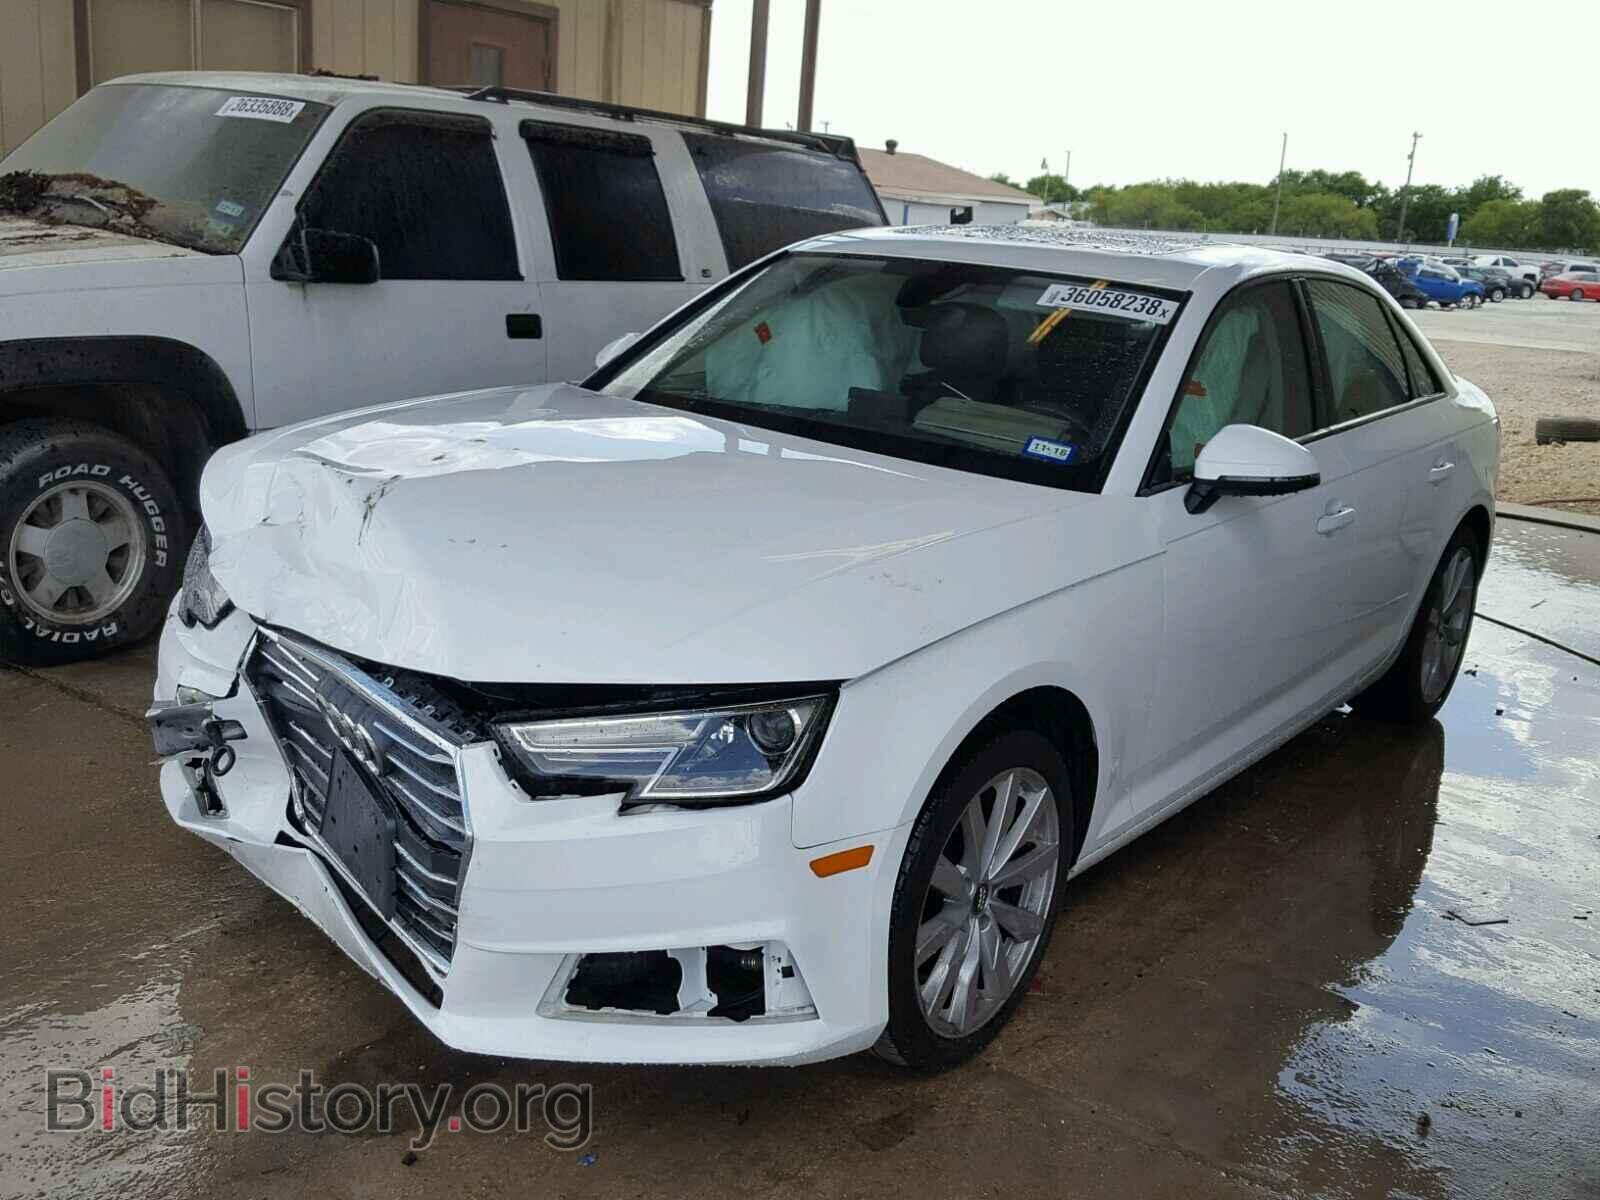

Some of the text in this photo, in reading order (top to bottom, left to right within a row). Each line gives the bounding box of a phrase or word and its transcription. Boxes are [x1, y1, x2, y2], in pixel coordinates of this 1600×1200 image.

[39, 463, 168, 567] ROAD HUGGER
[25, 616, 118, 643] RADIAL
